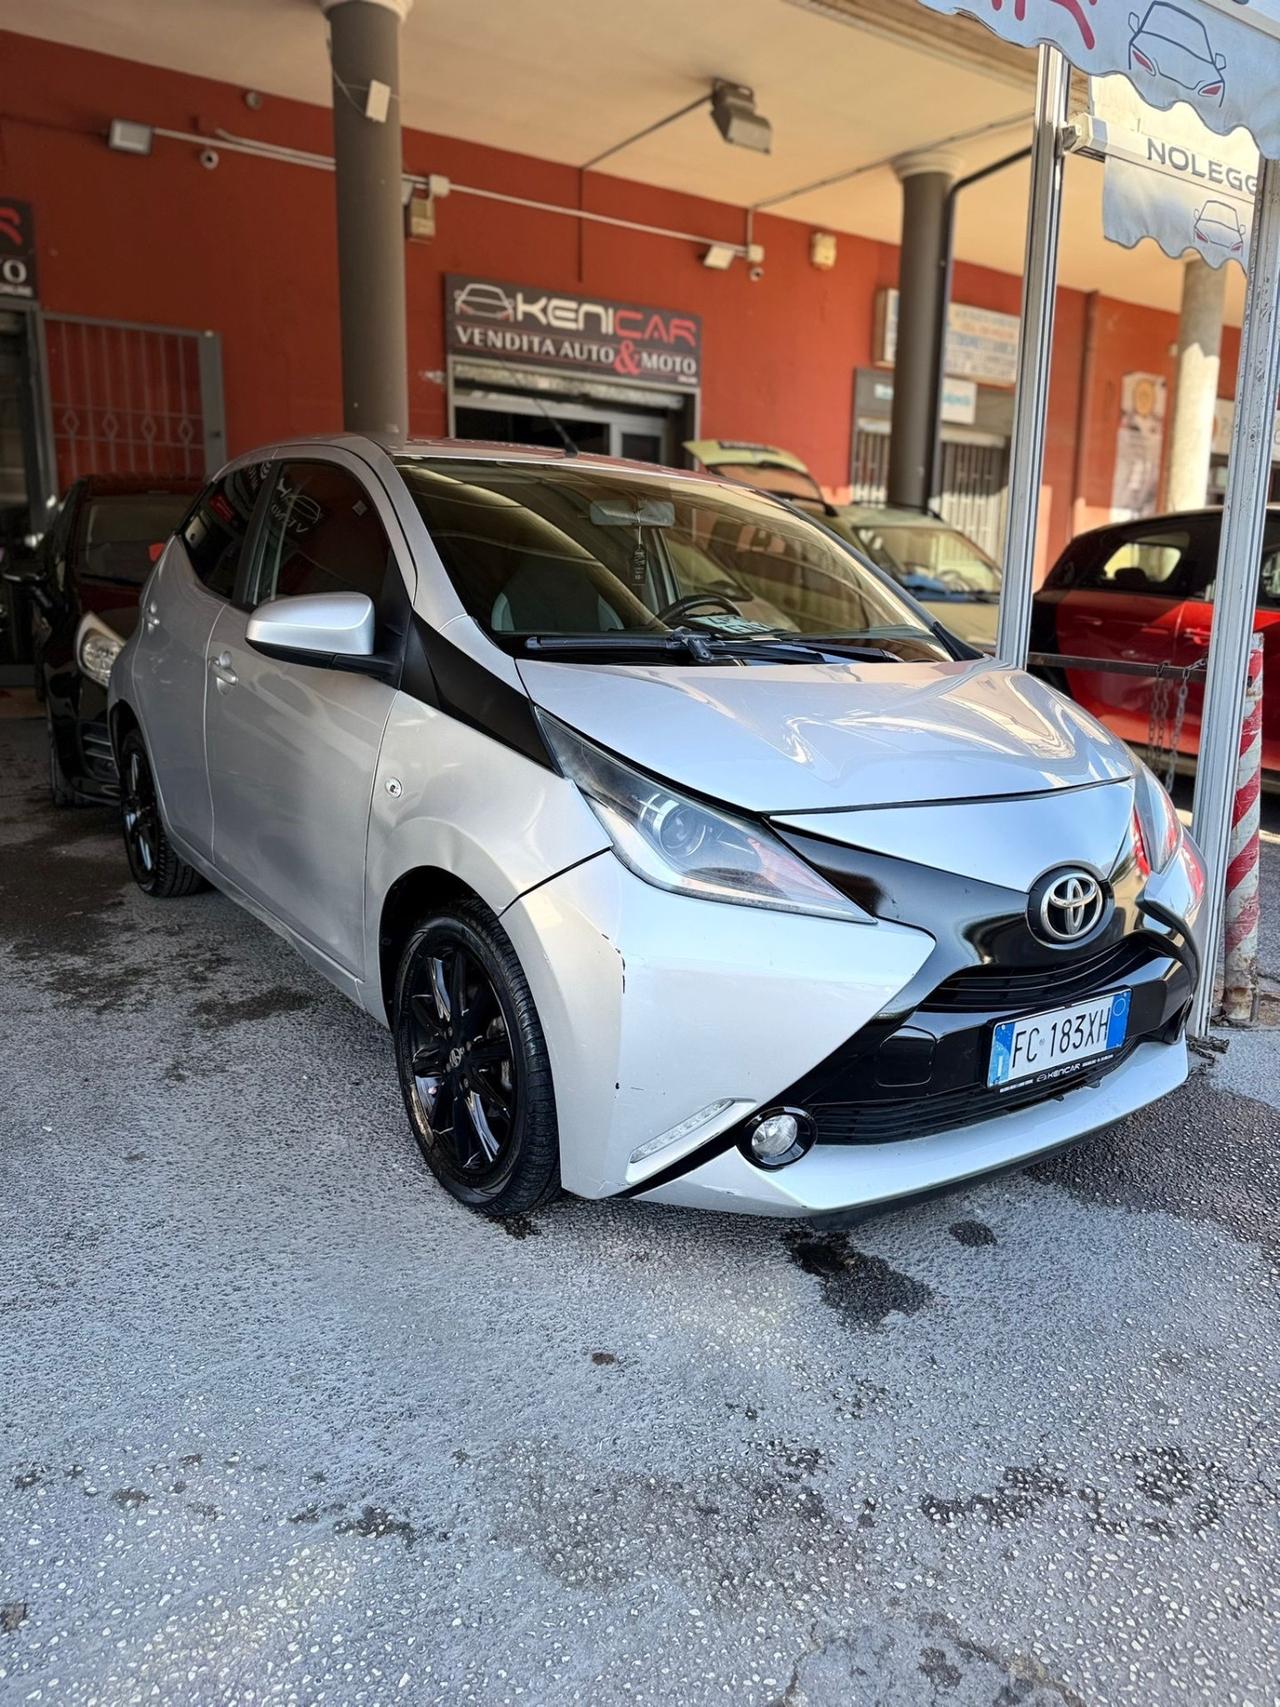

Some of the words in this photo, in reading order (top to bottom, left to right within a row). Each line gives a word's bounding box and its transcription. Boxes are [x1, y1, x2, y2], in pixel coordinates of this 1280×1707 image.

[516, 292, 697, 347] KENICAR
[455, 325, 556, 356] VENDITA
[559, 341, 615, 364] AUTO
[613, 339, 641, 375] &
[641, 352, 697, 375] MOTO
[1012, 1027, 1040, 1068] FC
[1050, 1007, 1112, 1057] 183XH
